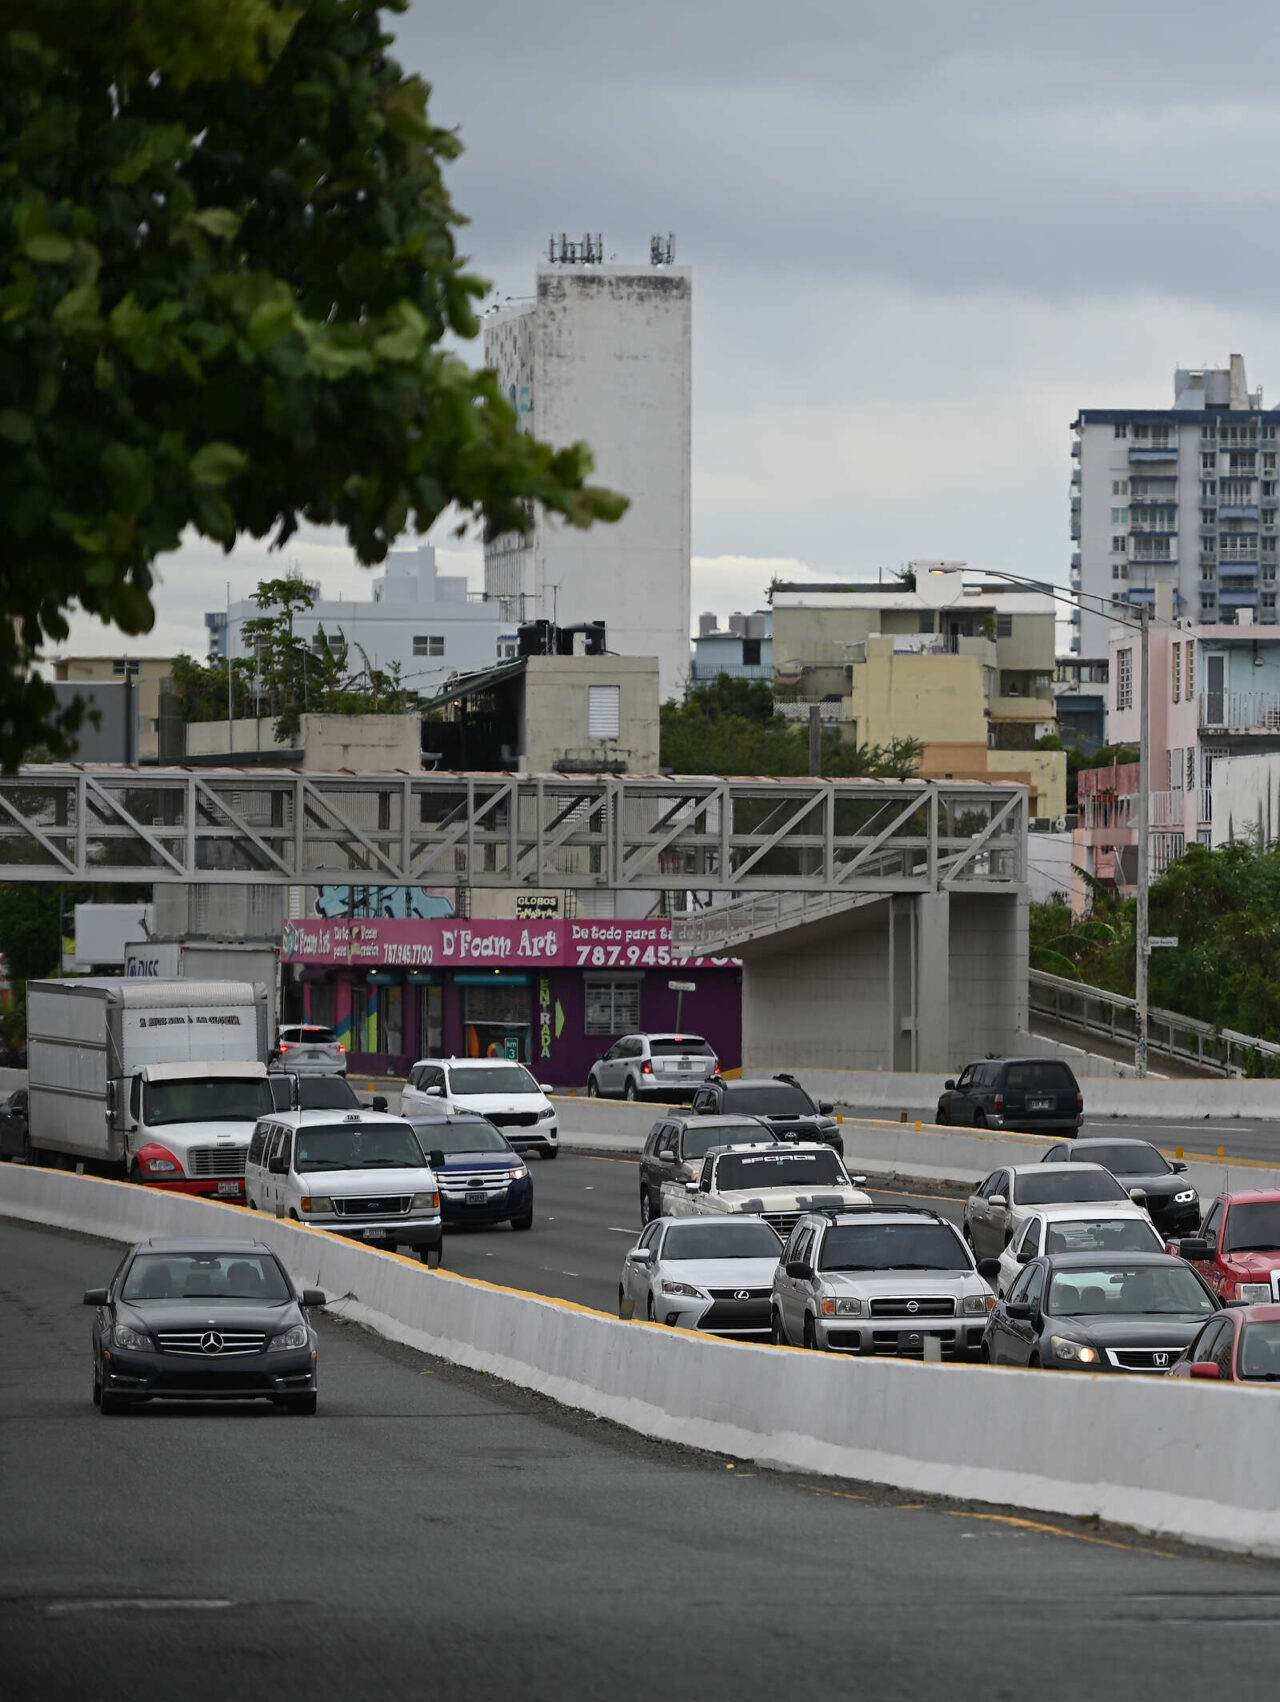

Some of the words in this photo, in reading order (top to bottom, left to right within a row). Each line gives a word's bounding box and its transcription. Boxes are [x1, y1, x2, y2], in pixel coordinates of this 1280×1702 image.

[518, 897, 556, 906] GLOBOS
[572, 925, 589, 940] De
[590, 925, 622, 940] todo
[625, 928, 656, 943] para
[442, 930, 511, 958] D'Foam
[517, 929, 558, 957] Art
[384, 944, 433, 964] 787.945.7700
[539, 978, 551, 1058] ENTRADA
[506, 1040, 517, 1048] km
[509, 1048, 516, 1059] 3
[751, 1155, 808, 1163] FORD
